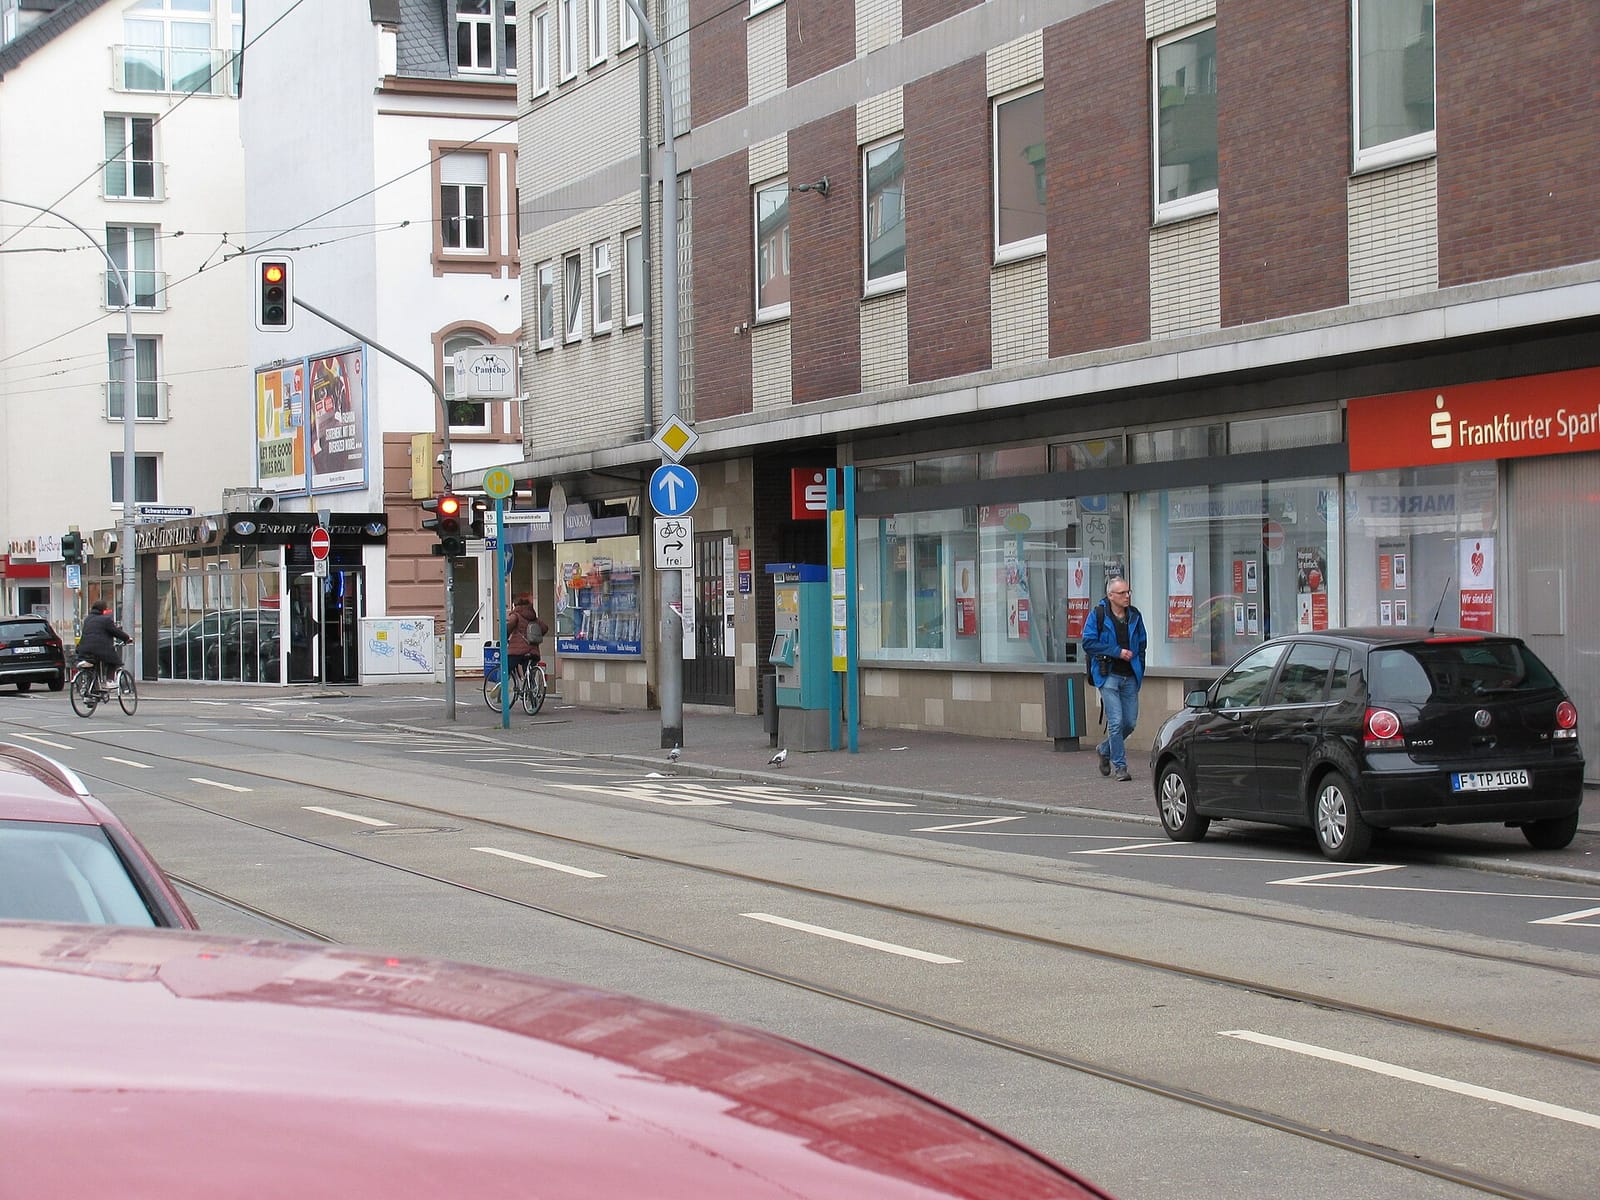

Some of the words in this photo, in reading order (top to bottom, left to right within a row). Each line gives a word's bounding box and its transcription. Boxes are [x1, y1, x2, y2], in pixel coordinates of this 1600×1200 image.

[1459, 413, 1552, 447] Frankfurter
[1556, 404, 1600, 443] Spar
[268, 444, 277, 458] THE
[277, 442, 292, 457] GOOD
[258, 523, 296, 534] ENPARI
[666, 557, 682, 566] frei
[1462, 593, 1472, 605] Wir
[1472, 592, 1484, 604] sind
[1484, 593, 1493, 604] da!
[1411, 739, 1434, 748] POLO
[1460, 774, 1468, 788] F
[543, 782, 917, 807] BUS
